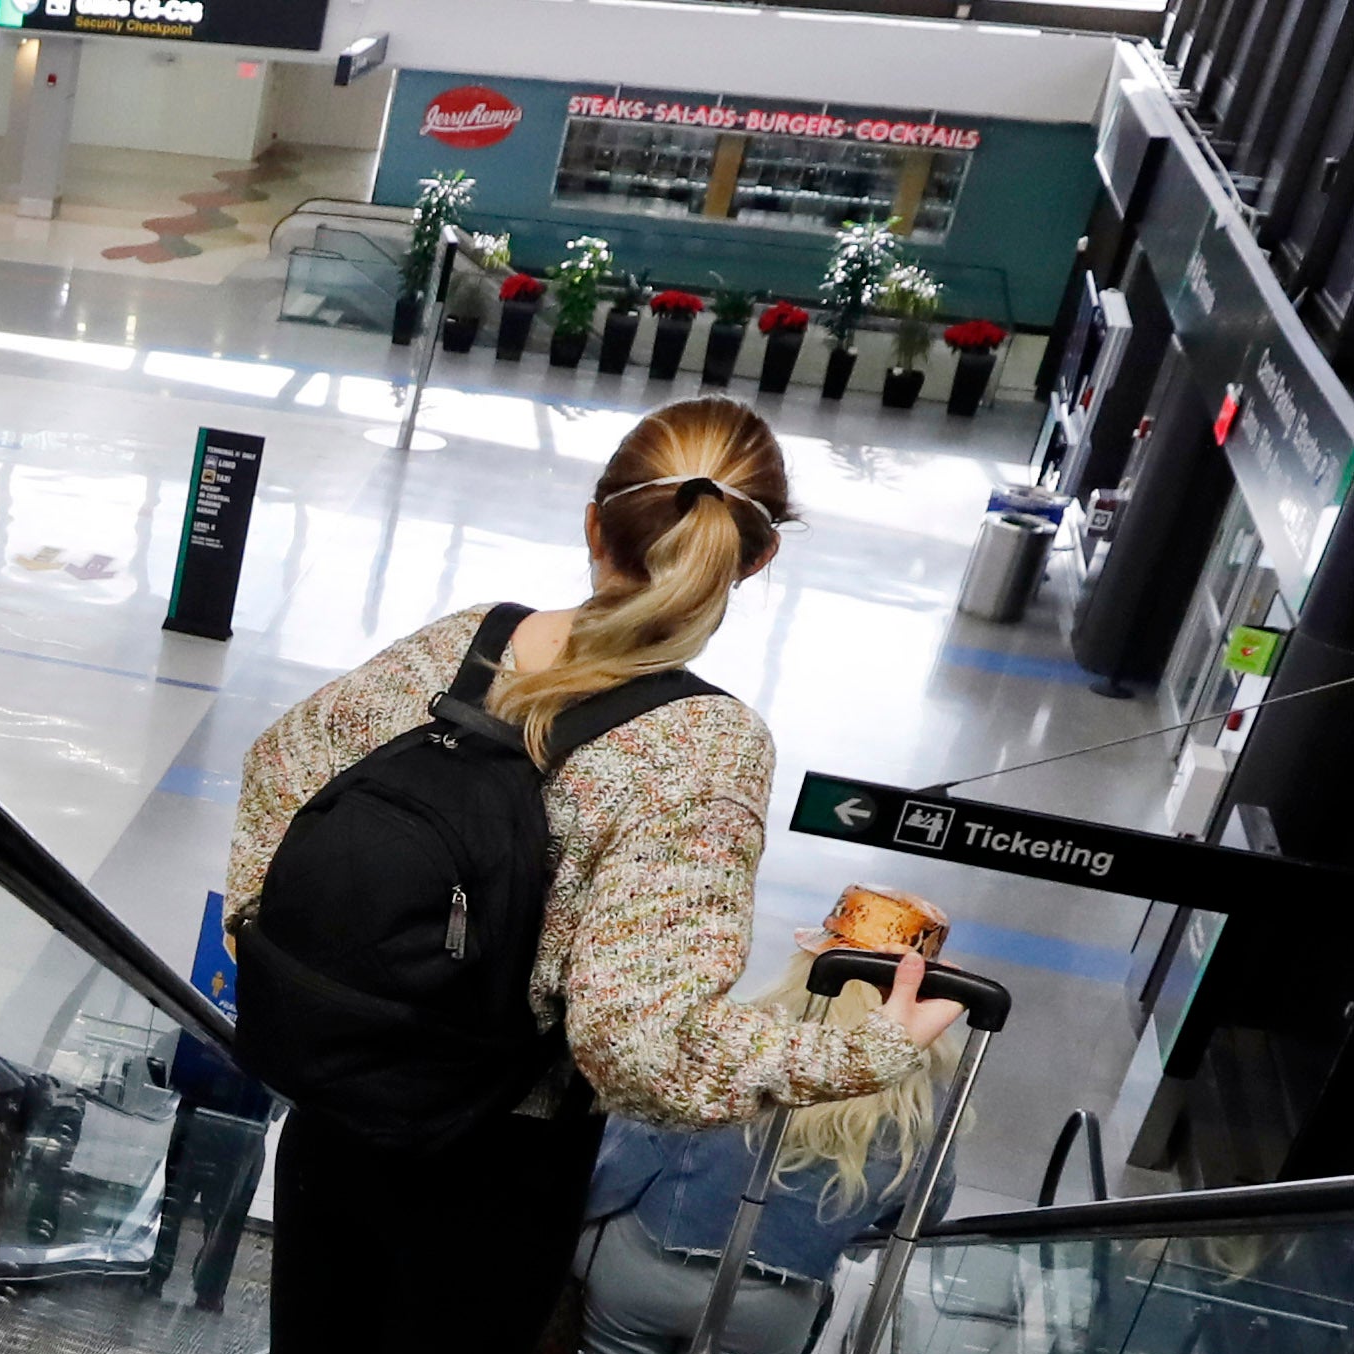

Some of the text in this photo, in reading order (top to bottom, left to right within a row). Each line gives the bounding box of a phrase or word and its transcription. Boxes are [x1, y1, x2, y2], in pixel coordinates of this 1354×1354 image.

[75, 15, 194, 36] Security Checkpoint
[420, 103, 523, 136] Jerry Remy's
[567, 94, 980, 150] STEAKS SALADS BURGERS COCKTAILS
[218, 459, 236, 470] LIMO
[216, 473, 232, 484] TAXI
[964, 821, 1115, 876] Ticketing
